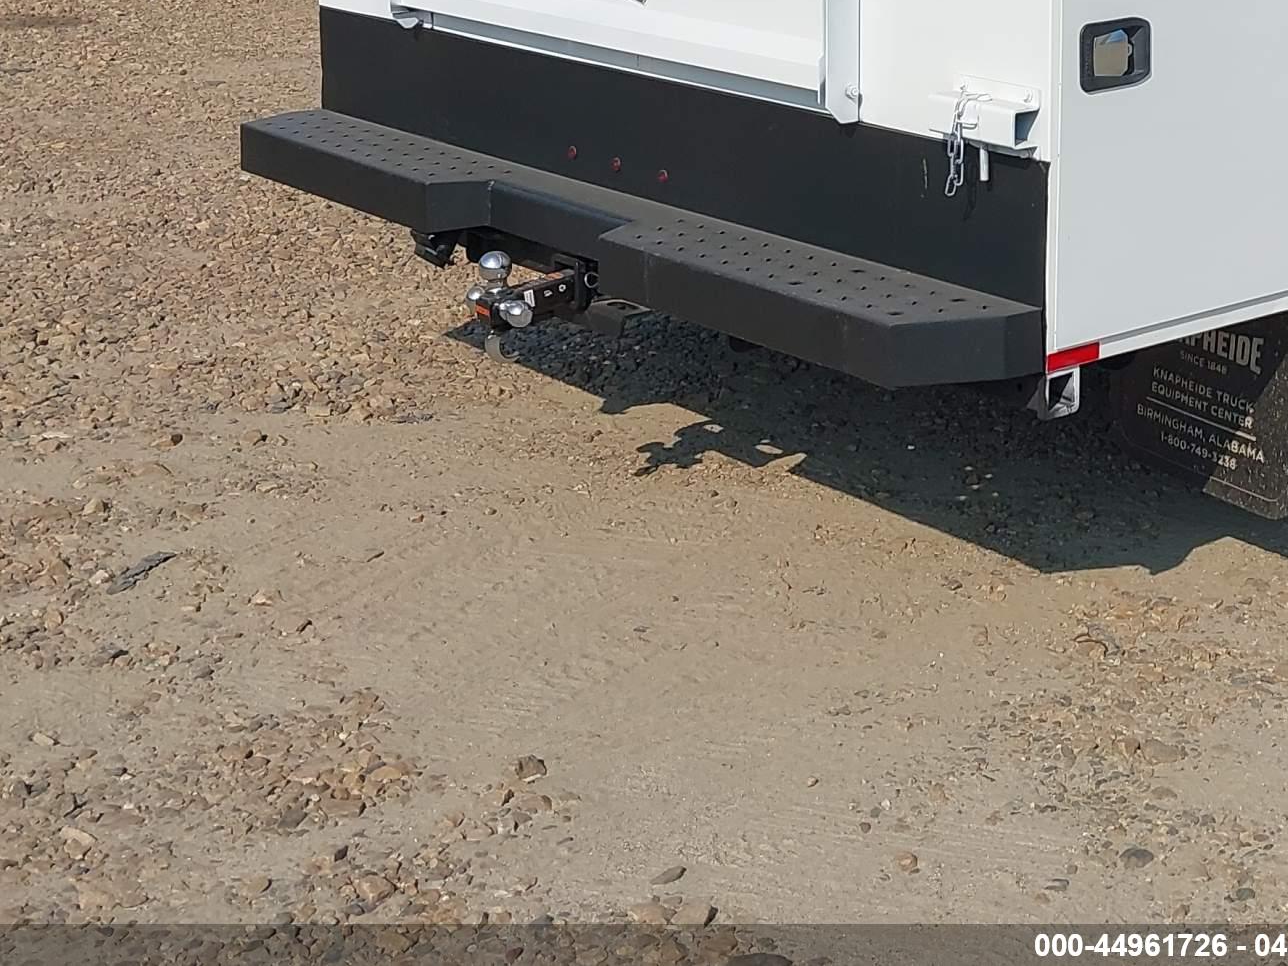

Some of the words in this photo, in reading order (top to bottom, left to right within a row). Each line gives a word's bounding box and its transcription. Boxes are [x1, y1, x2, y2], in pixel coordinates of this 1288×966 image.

[1151, 381, 1208, 412] EQUIPMENT
[1211, 405, 1254, 429] CENTER
[1153, 367, 1213, 398] KNAPHEIDE
[1216, 390, 1255, 413] TRUCK
[1137, 403, 1206, 442] BIRMINGHAM,
[1208, 434, 1265, 464] ALABAMA
